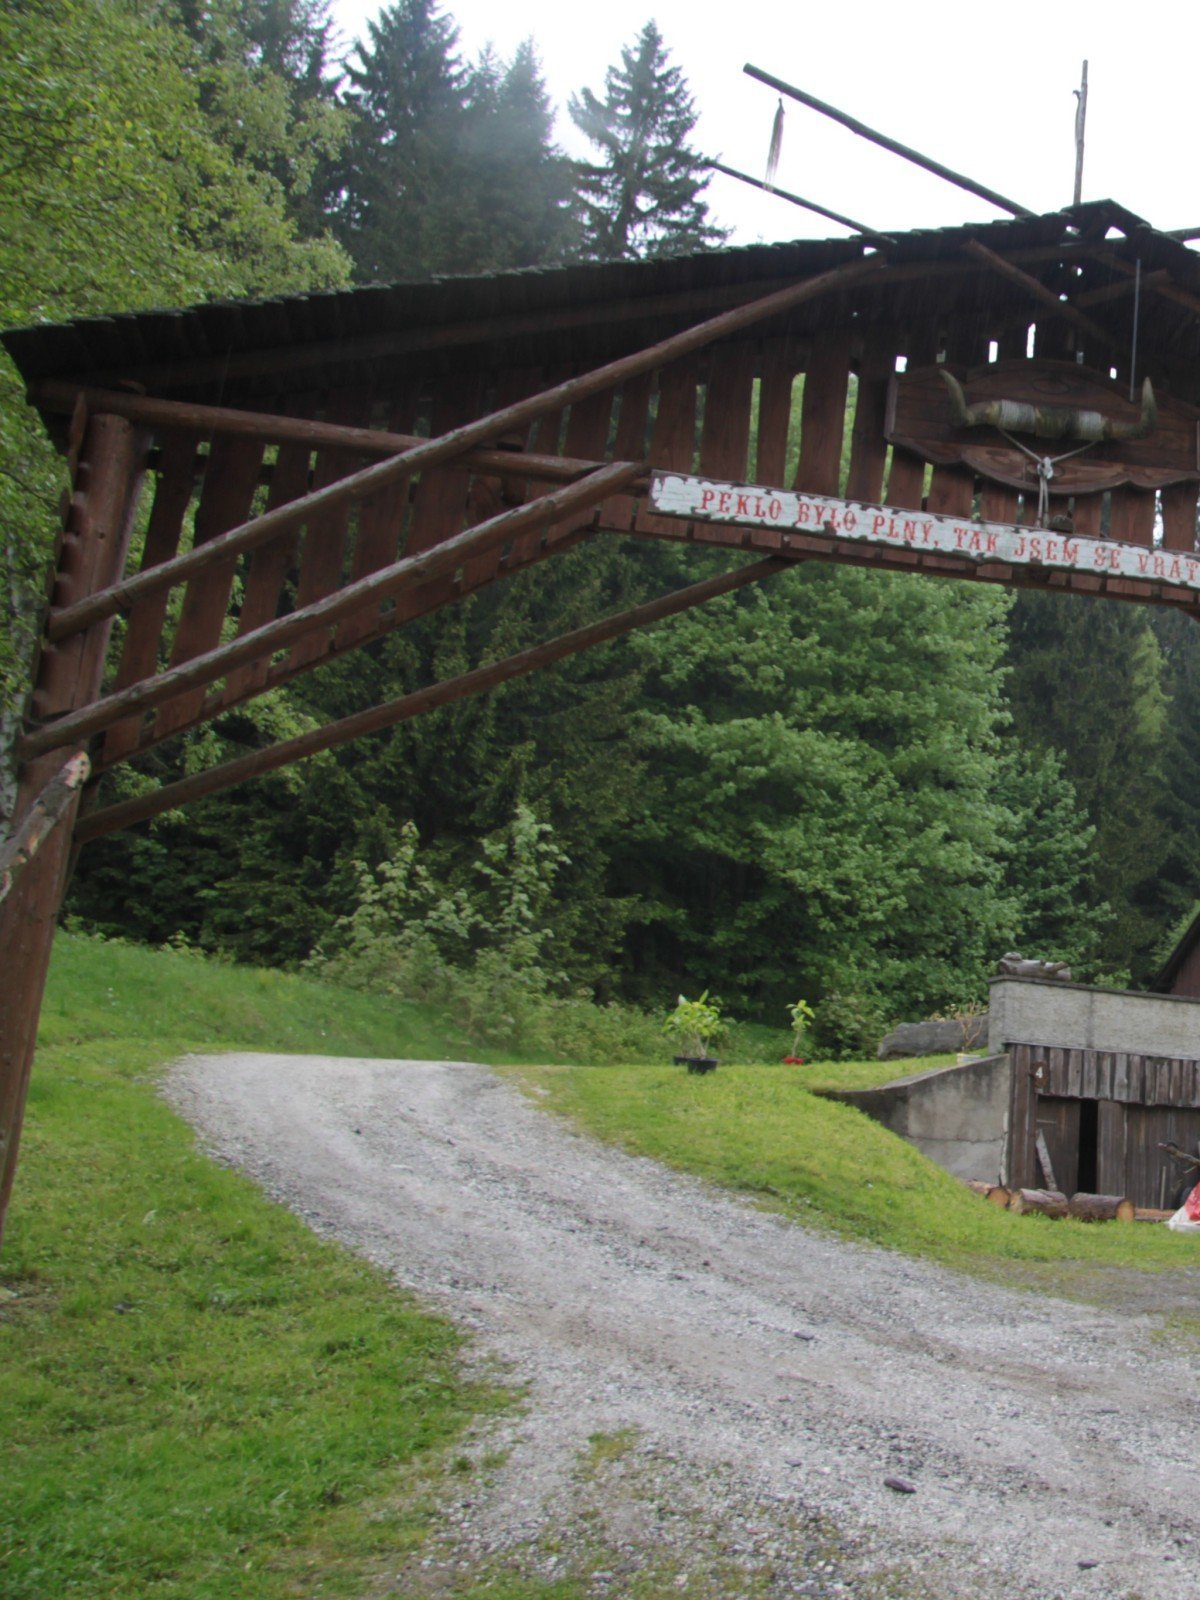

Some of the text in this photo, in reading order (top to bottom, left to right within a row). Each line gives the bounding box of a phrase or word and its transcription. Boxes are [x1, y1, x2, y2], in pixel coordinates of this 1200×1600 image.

[700, 489, 782, 520] PEKLO
[795, 501, 857, 531] BYLO
[953, 526, 1001, 553] TAK
[1014, 536, 1079, 563] JSEM
[1093, 546, 1120, 569] SE
[1035, 1066, 1043, 1079] 4
